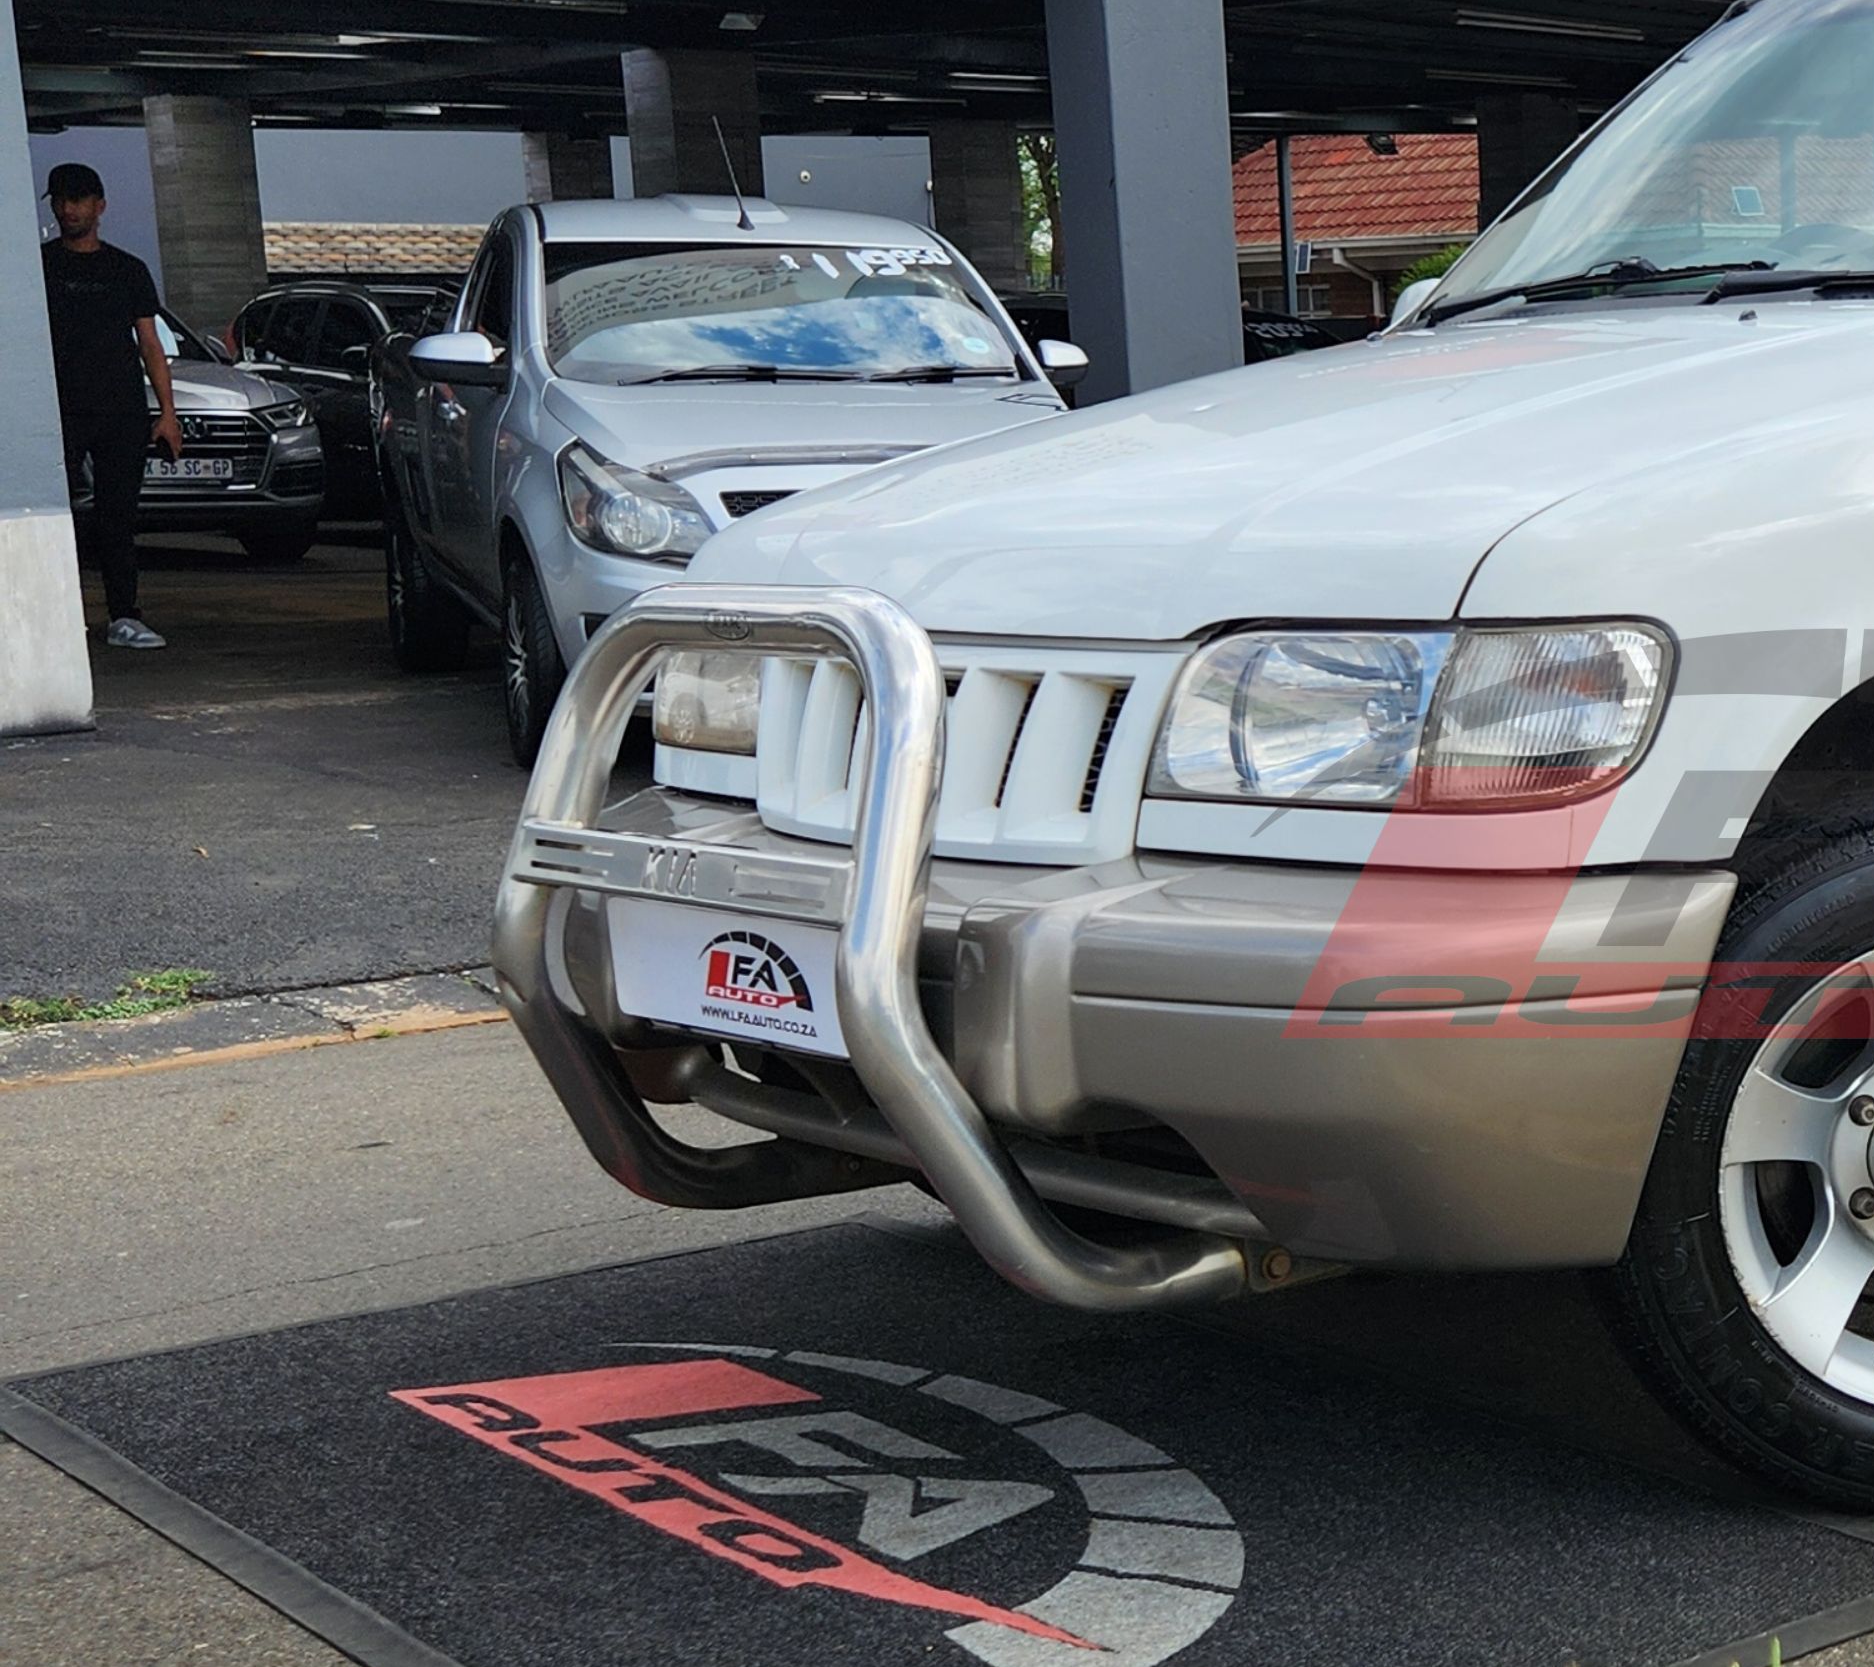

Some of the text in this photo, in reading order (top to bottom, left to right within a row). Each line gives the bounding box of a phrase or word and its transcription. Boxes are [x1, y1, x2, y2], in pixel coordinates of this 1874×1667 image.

[184, 460, 201, 475] SC
[213, 460, 229, 475] GP
[641, 845, 697, 897] KIA
[708, 985, 779, 1007] AUTO
[418, 1393, 846, 1572] AUTO
